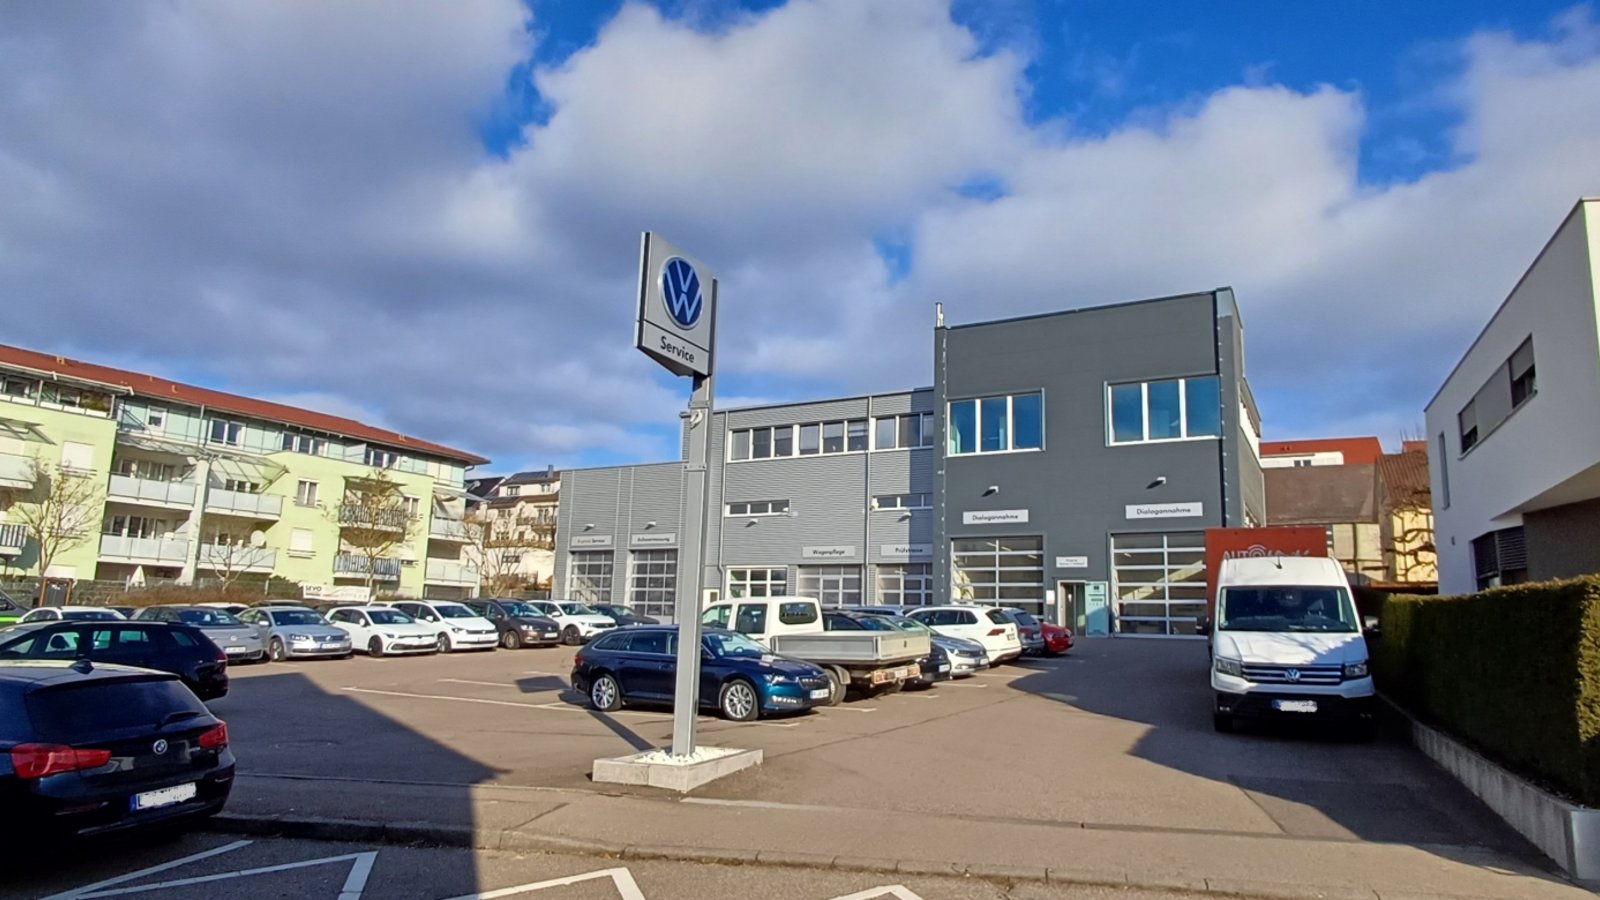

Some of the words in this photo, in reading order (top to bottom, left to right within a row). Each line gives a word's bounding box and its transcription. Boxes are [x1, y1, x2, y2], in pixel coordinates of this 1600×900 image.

[660, 335, 695, 363] Service
[1136, 506, 1191, 515] Dialogannahme
[972, 513, 1018, 521] Dialogannahme
[812, 547, 846, 556] Wagenpflege
